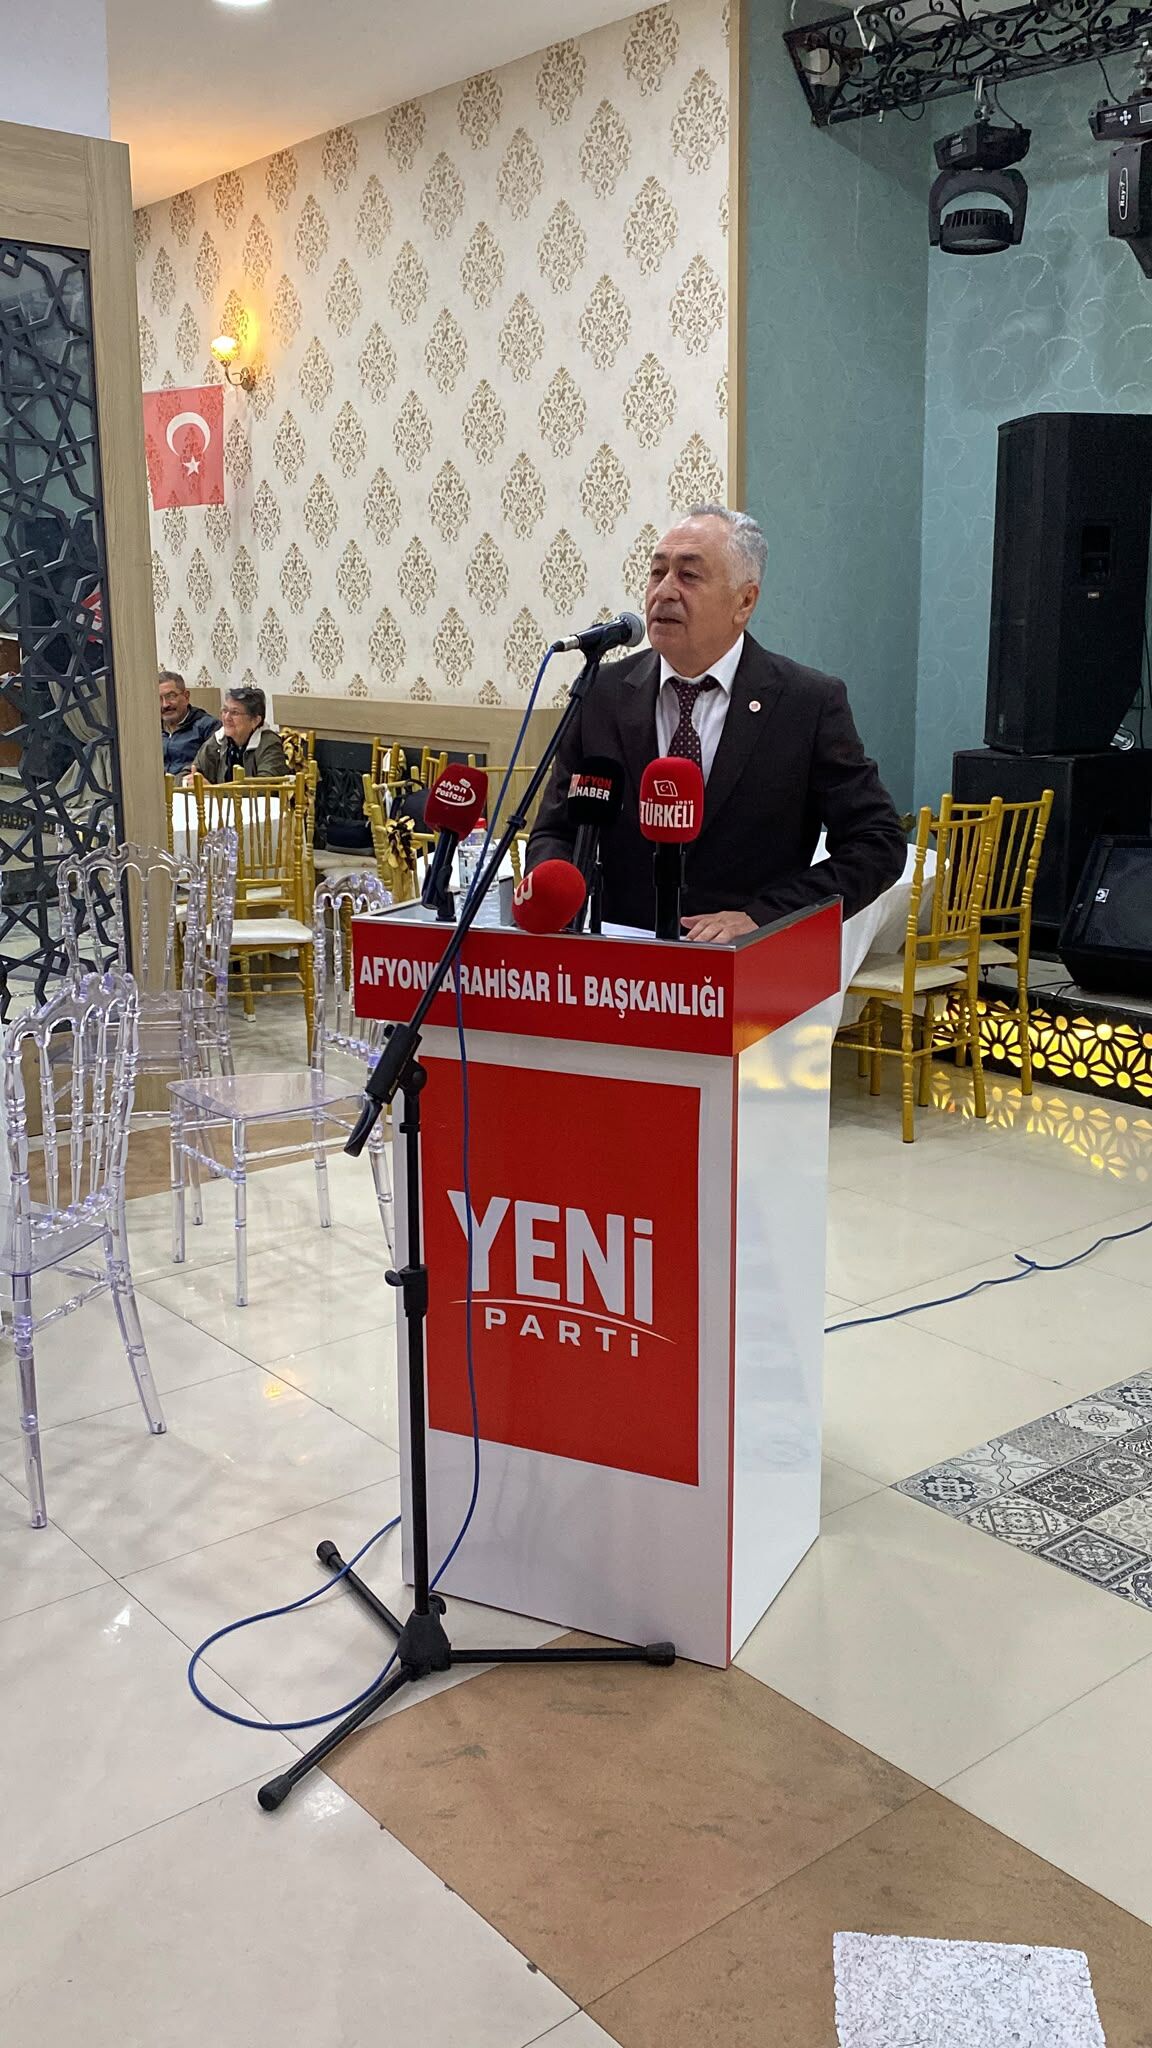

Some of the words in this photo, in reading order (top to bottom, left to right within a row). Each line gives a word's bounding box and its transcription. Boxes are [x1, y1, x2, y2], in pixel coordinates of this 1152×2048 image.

[439, 780, 467, 795] Afyon
[579, 775, 612, 790] AFYON
[576, 786, 610, 801] HABER
[640, 797, 694, 828] TÜRKELİ
[557, 963, 578, 1006] İL
[584, 976, 725, 1019] BAŞKANLIĞI
